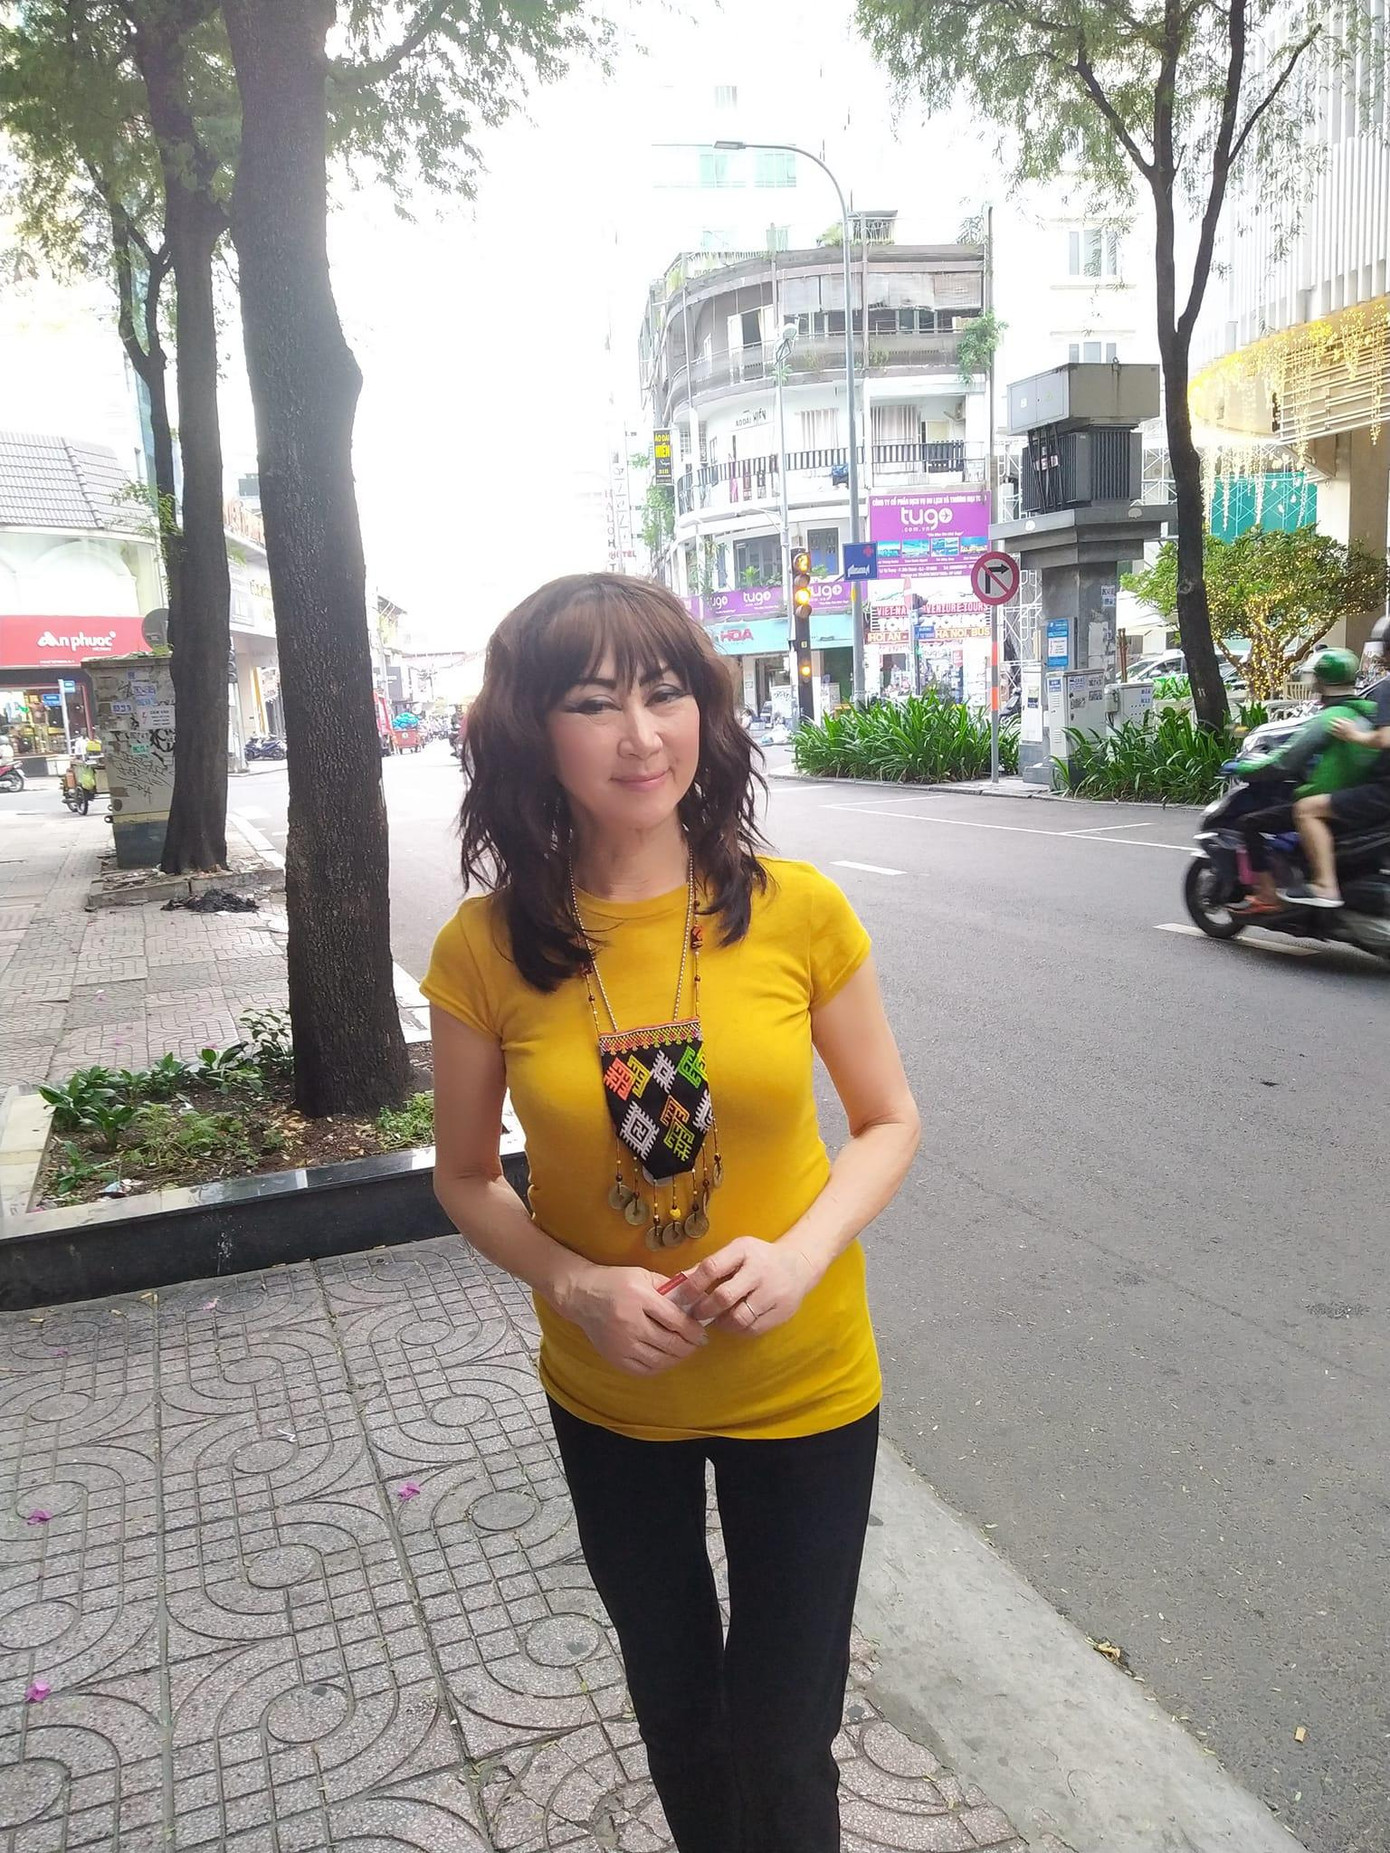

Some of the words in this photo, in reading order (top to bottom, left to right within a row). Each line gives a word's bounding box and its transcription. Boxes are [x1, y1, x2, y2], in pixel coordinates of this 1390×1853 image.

[901, 506, 953, 532] tugo
[743, 590, 772, 606] tugo
[810, 583, 843, 602] ugo
